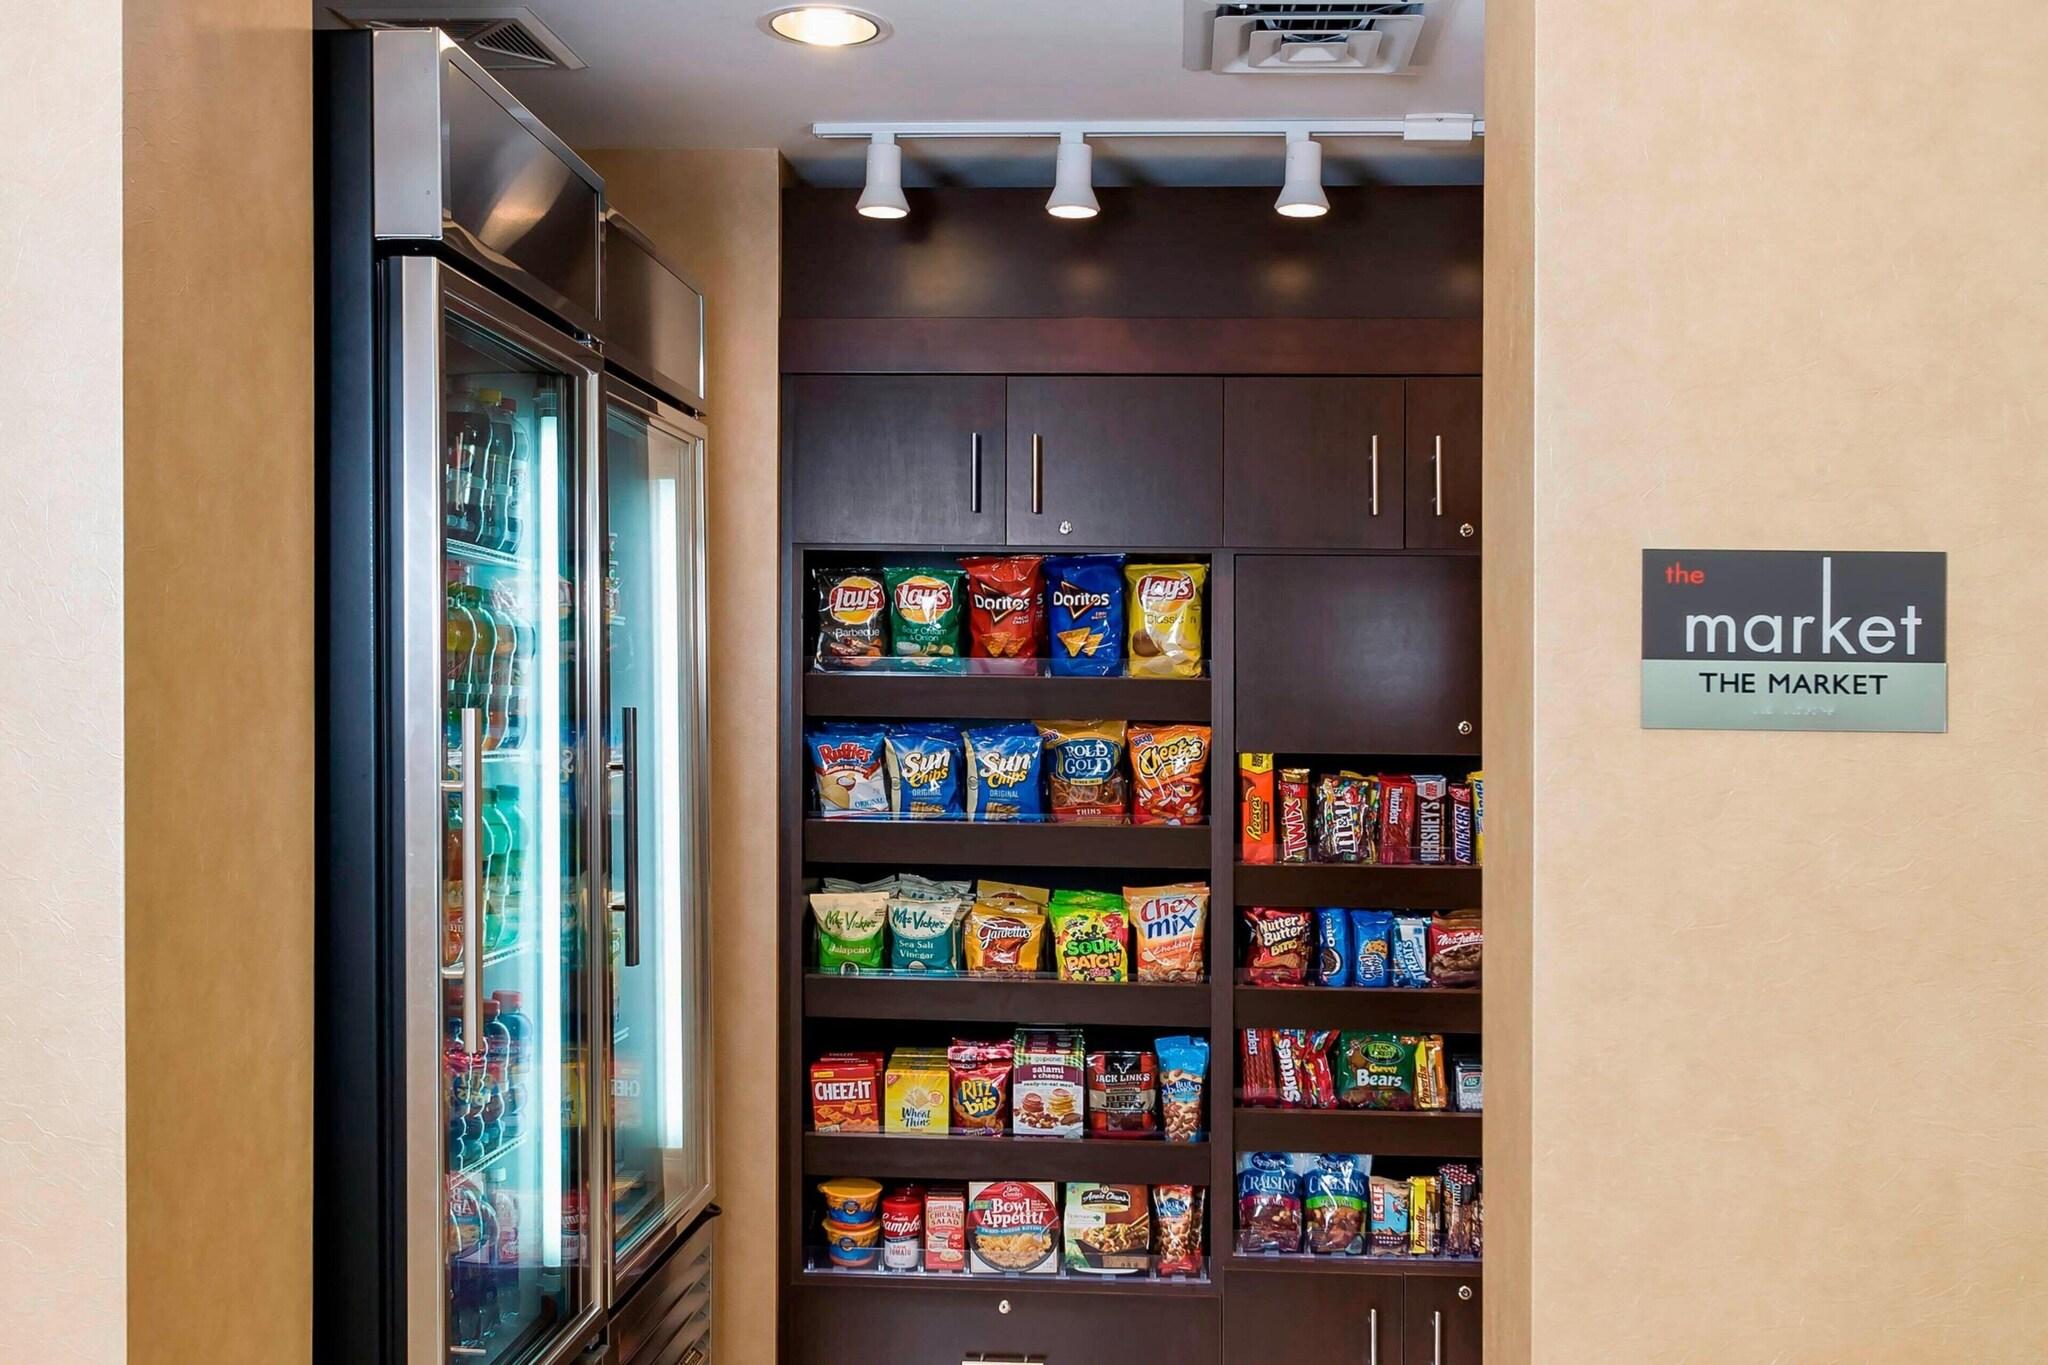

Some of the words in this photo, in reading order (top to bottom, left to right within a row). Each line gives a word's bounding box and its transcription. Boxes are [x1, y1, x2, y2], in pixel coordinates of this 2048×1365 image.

[1665, 562, 1705, 585] the
[898, 585, 948, 610] Lay's
[1053, 591, 1110, 607] Doritos
[1144, 576, 1190, 602] Lay's
[835, 587, 880, 612] Lay's
[974, 593, 1030, 611] Doritos
[1686, 557, 1922, 656] market
[836, 628, 881, 640] Barbeque
[1699, 673, 1756, 695] THE
[1768, 673, 1888, 696] MARKET
[1065, 742, 1108, 759] ROLD
[902, 751, 950, 778] Sun
[979, 751, 1030, 777] Sun
[1065, 757, 1112, 774] GOLD
[910, 766, 948, 788] Chips
[988, 768, 1027, 788] Chips
[854, 797, 886, 809] ORIGINAL
[912, 789, 942, 798] ORIGINAL
[990, 790, 1019, 798] ORIGINAL
[1076, 808, 1102, 816] THINS
[1389, 786, 1404, 825] Twizzlers
[1420, 801, 1440, 862] HERSHEY'S
[1454, 803, 1471, 864] SNICKERS
[1140, 895, 1198, 922] Chex
[1147, 908, 1198, 939] mix
[1257, 915, 1299, 932] Nutter
[1326, 917, 1336, 948] OREO
[899, 939, 915, 948] Sea
[917, 939, 934, 949] Salt
[1263, 925, 1304, 946] Butter
[899, 950, 935, 962] Vinegar
[1067, 938, 1119, 955] SOUR
[1066, 953, 1121, 971] PATCH
[1402, 940, 1425, 980] TREATS
[1032, 1065, 1065, 1074] salami
[1096, 1074, 1118, 1083] JACK
[1277, 1038, 1301, 1103] Skittles
[1357, 1068, 1403, 1087] Bears
[1418, 1063, 1430, 1104] PowerBar
[902, 1107, 931, 1119] Wheat
[963, 1096, 997, 1115] bits
[900, 1118, 931, 1128] Thins
[1242, 1174, 1298, 1197] CRAISINS
[991, 1198, 1030, 1214] Bowl
[1373, 1185, 1385, 1213] CLIF
[1415, 1207, 1426, 1248] PowerBar
